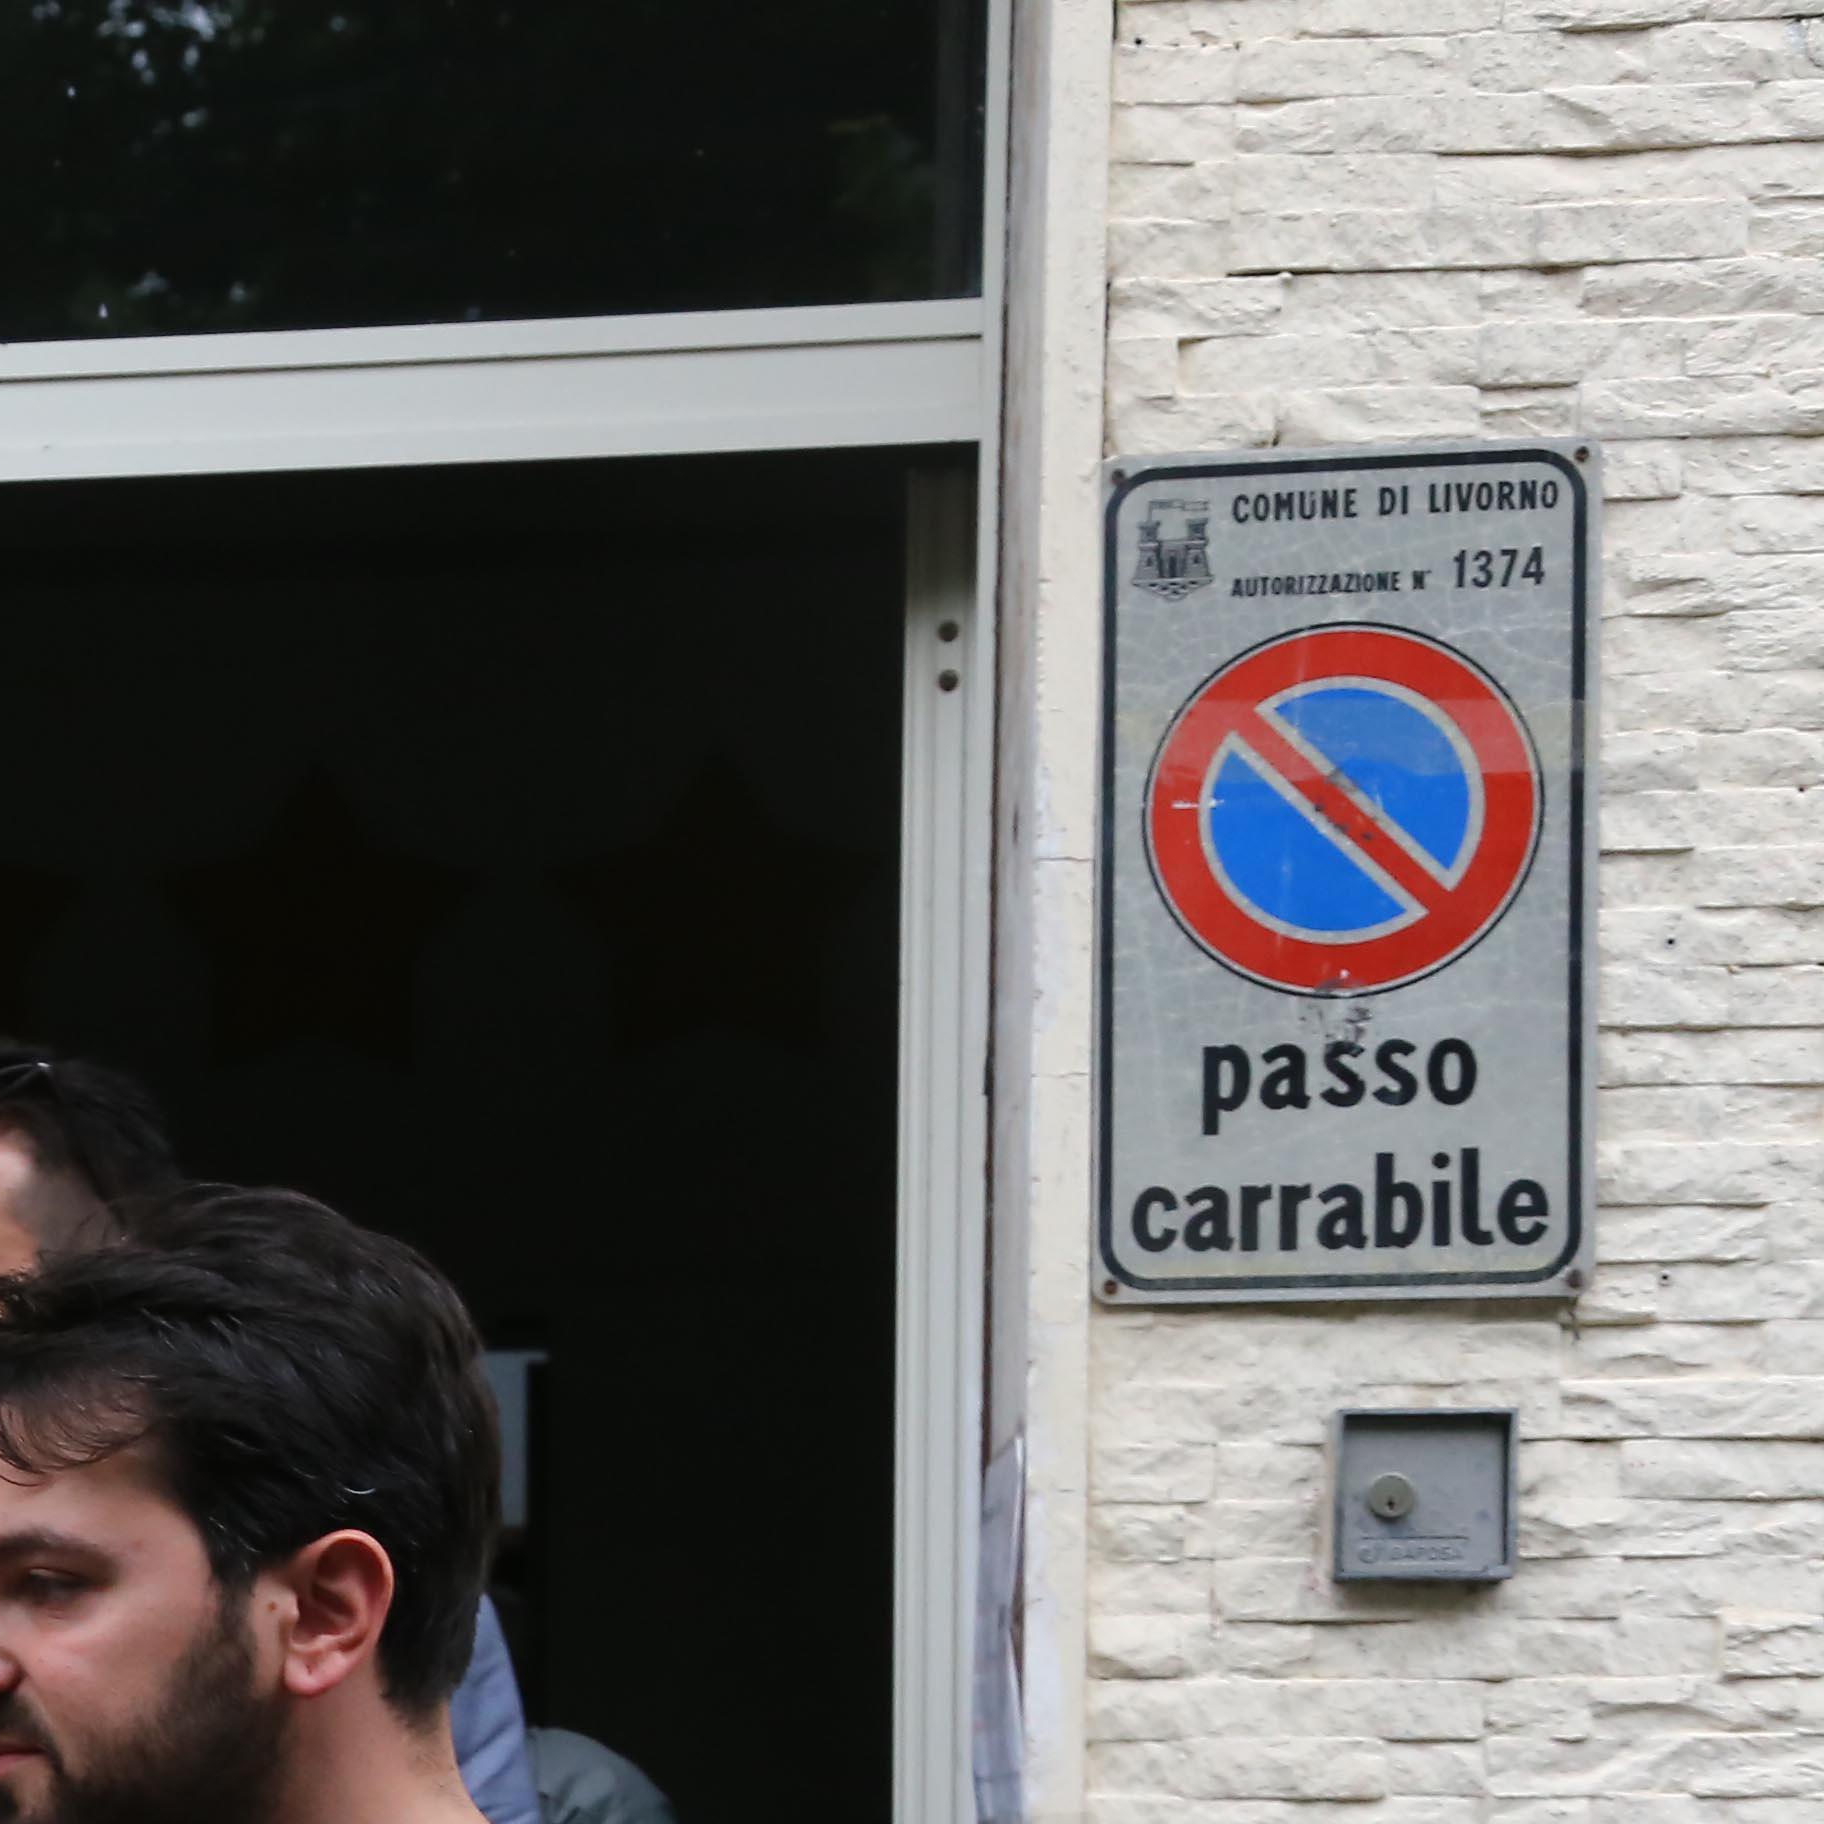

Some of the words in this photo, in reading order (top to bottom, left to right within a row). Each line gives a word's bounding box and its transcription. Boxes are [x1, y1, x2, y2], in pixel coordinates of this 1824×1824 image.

[1232, 488, 1358, 523] COMUNE
[1378, 485, 1409, 515] DI
[1429, 480, 1559, 513] LIVORNO
[1231, 571, 1401, 598] AUTORIZZAZIONE
[1453, 546, 1545, 589] 1374
[1202, 1036, 1479, 1137] passo
[1131, 1147, 1550, 1254] carrabile
